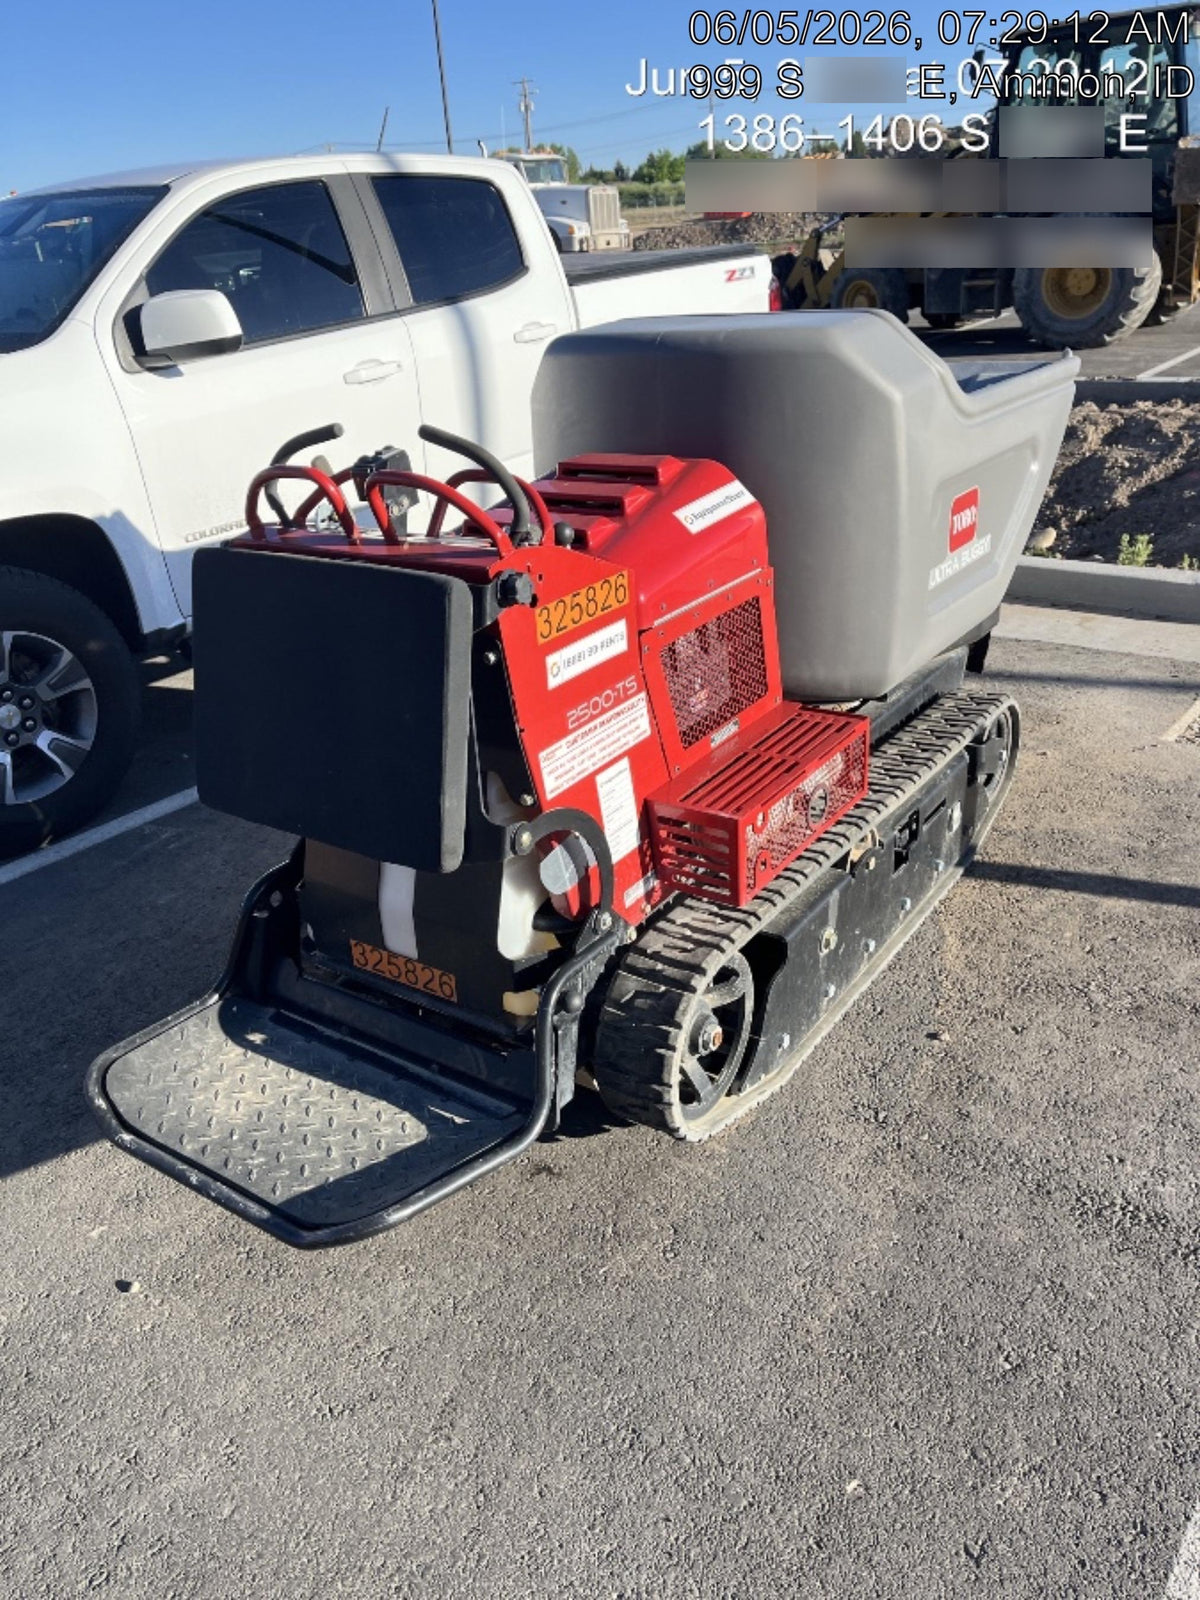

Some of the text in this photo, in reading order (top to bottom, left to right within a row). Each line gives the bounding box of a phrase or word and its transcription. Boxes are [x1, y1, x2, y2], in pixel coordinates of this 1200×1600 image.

[185, 519, 249, 543] COLORAD
[537, 572, 628, 640] 325826
[353, 942, 455, 999] 325826
